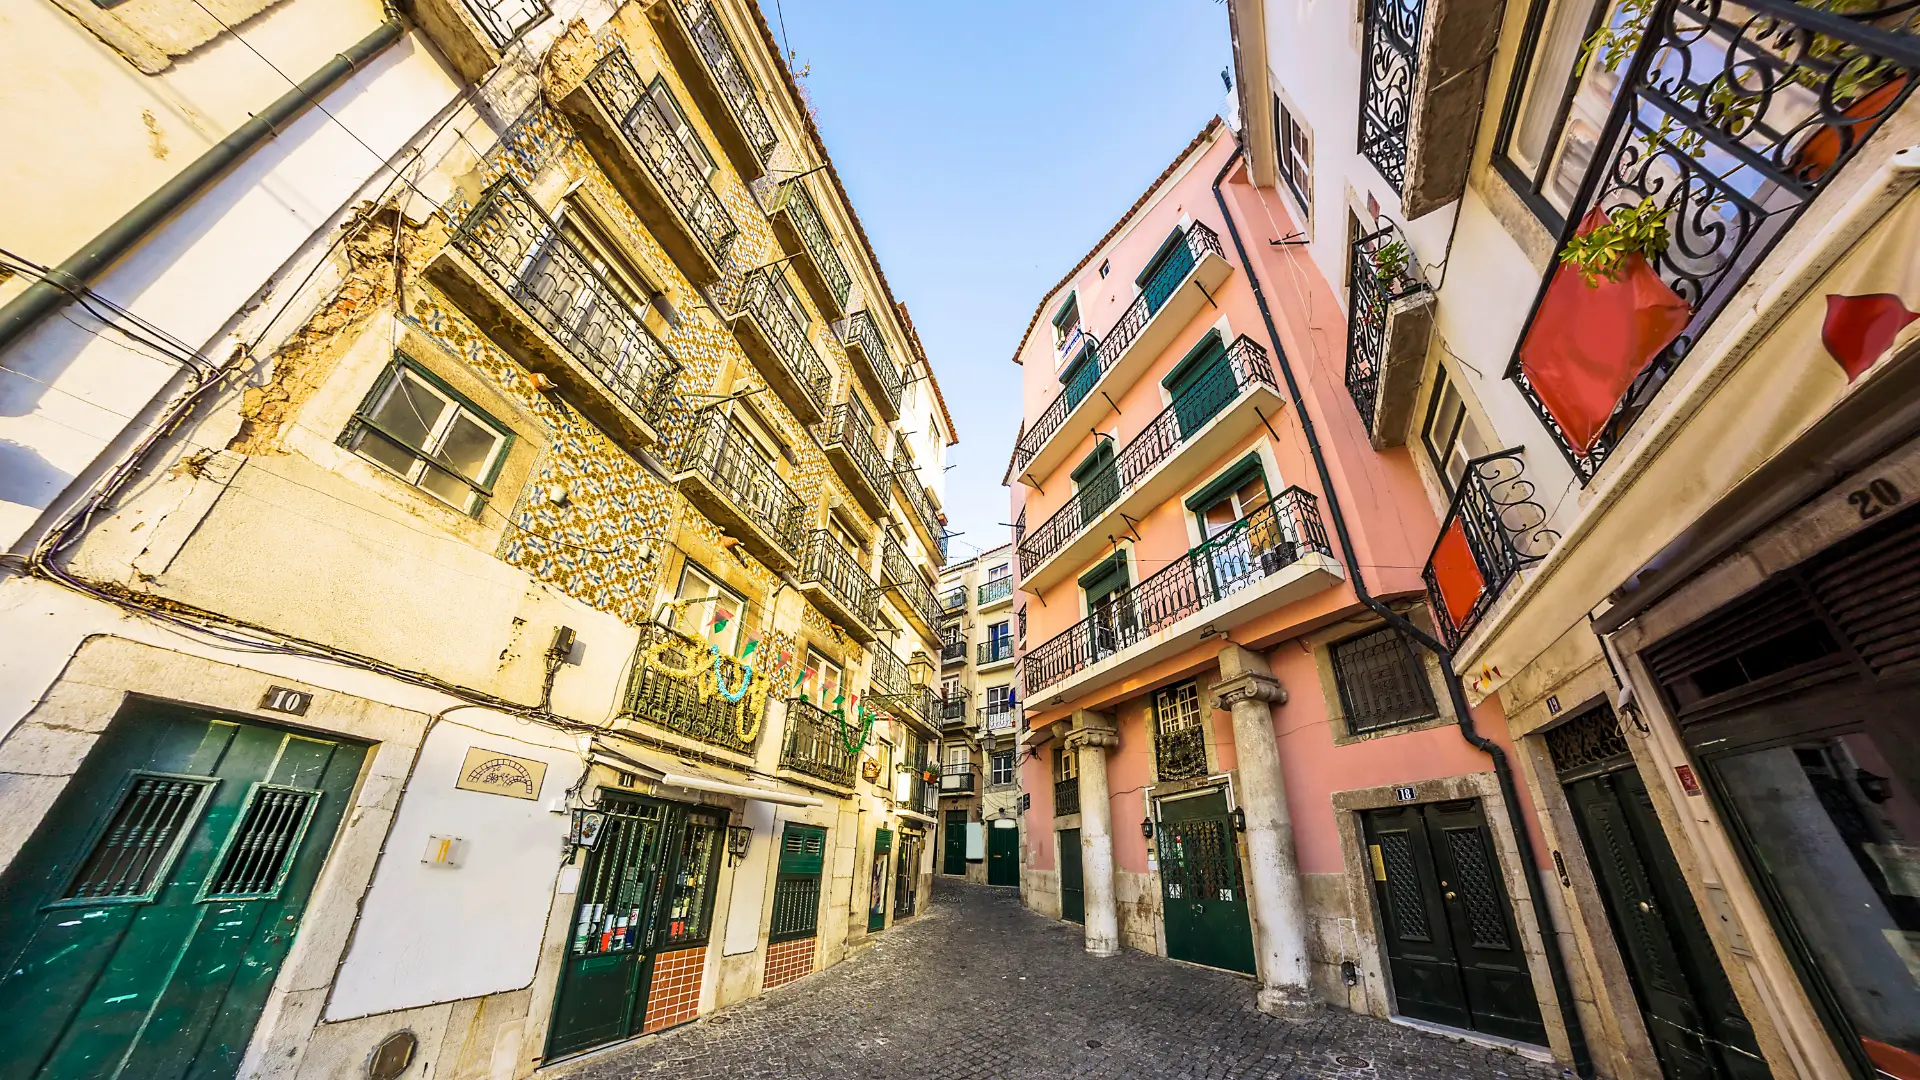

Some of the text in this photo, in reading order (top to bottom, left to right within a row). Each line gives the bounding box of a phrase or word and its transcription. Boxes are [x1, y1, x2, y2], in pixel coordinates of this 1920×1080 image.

[1848, 478, 1901, 520] 20
[271, 690, 301, 711] 10
[1548, 697, 1559, 713] 19
[1400, 788, 1411, 800] 18
